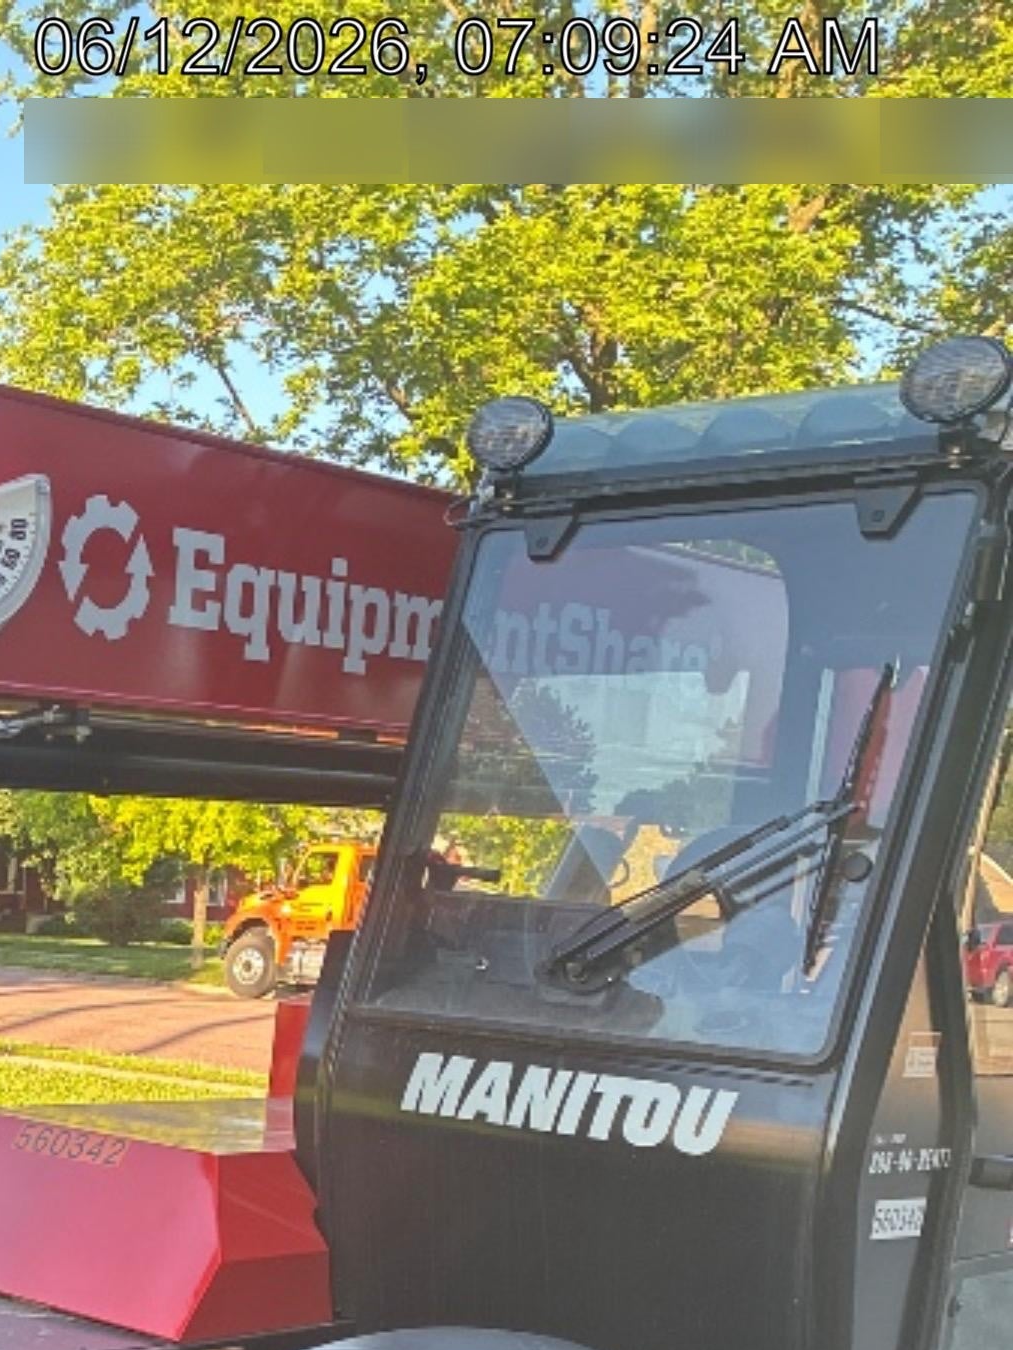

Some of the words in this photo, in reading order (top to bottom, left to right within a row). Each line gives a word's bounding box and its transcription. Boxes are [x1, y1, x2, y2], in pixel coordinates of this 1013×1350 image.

[167, 526, 710, 676] EquipmntShare
[14, 1122, 127, 1166] 560342
[400, 1052, 740, 1157] MANITOU
